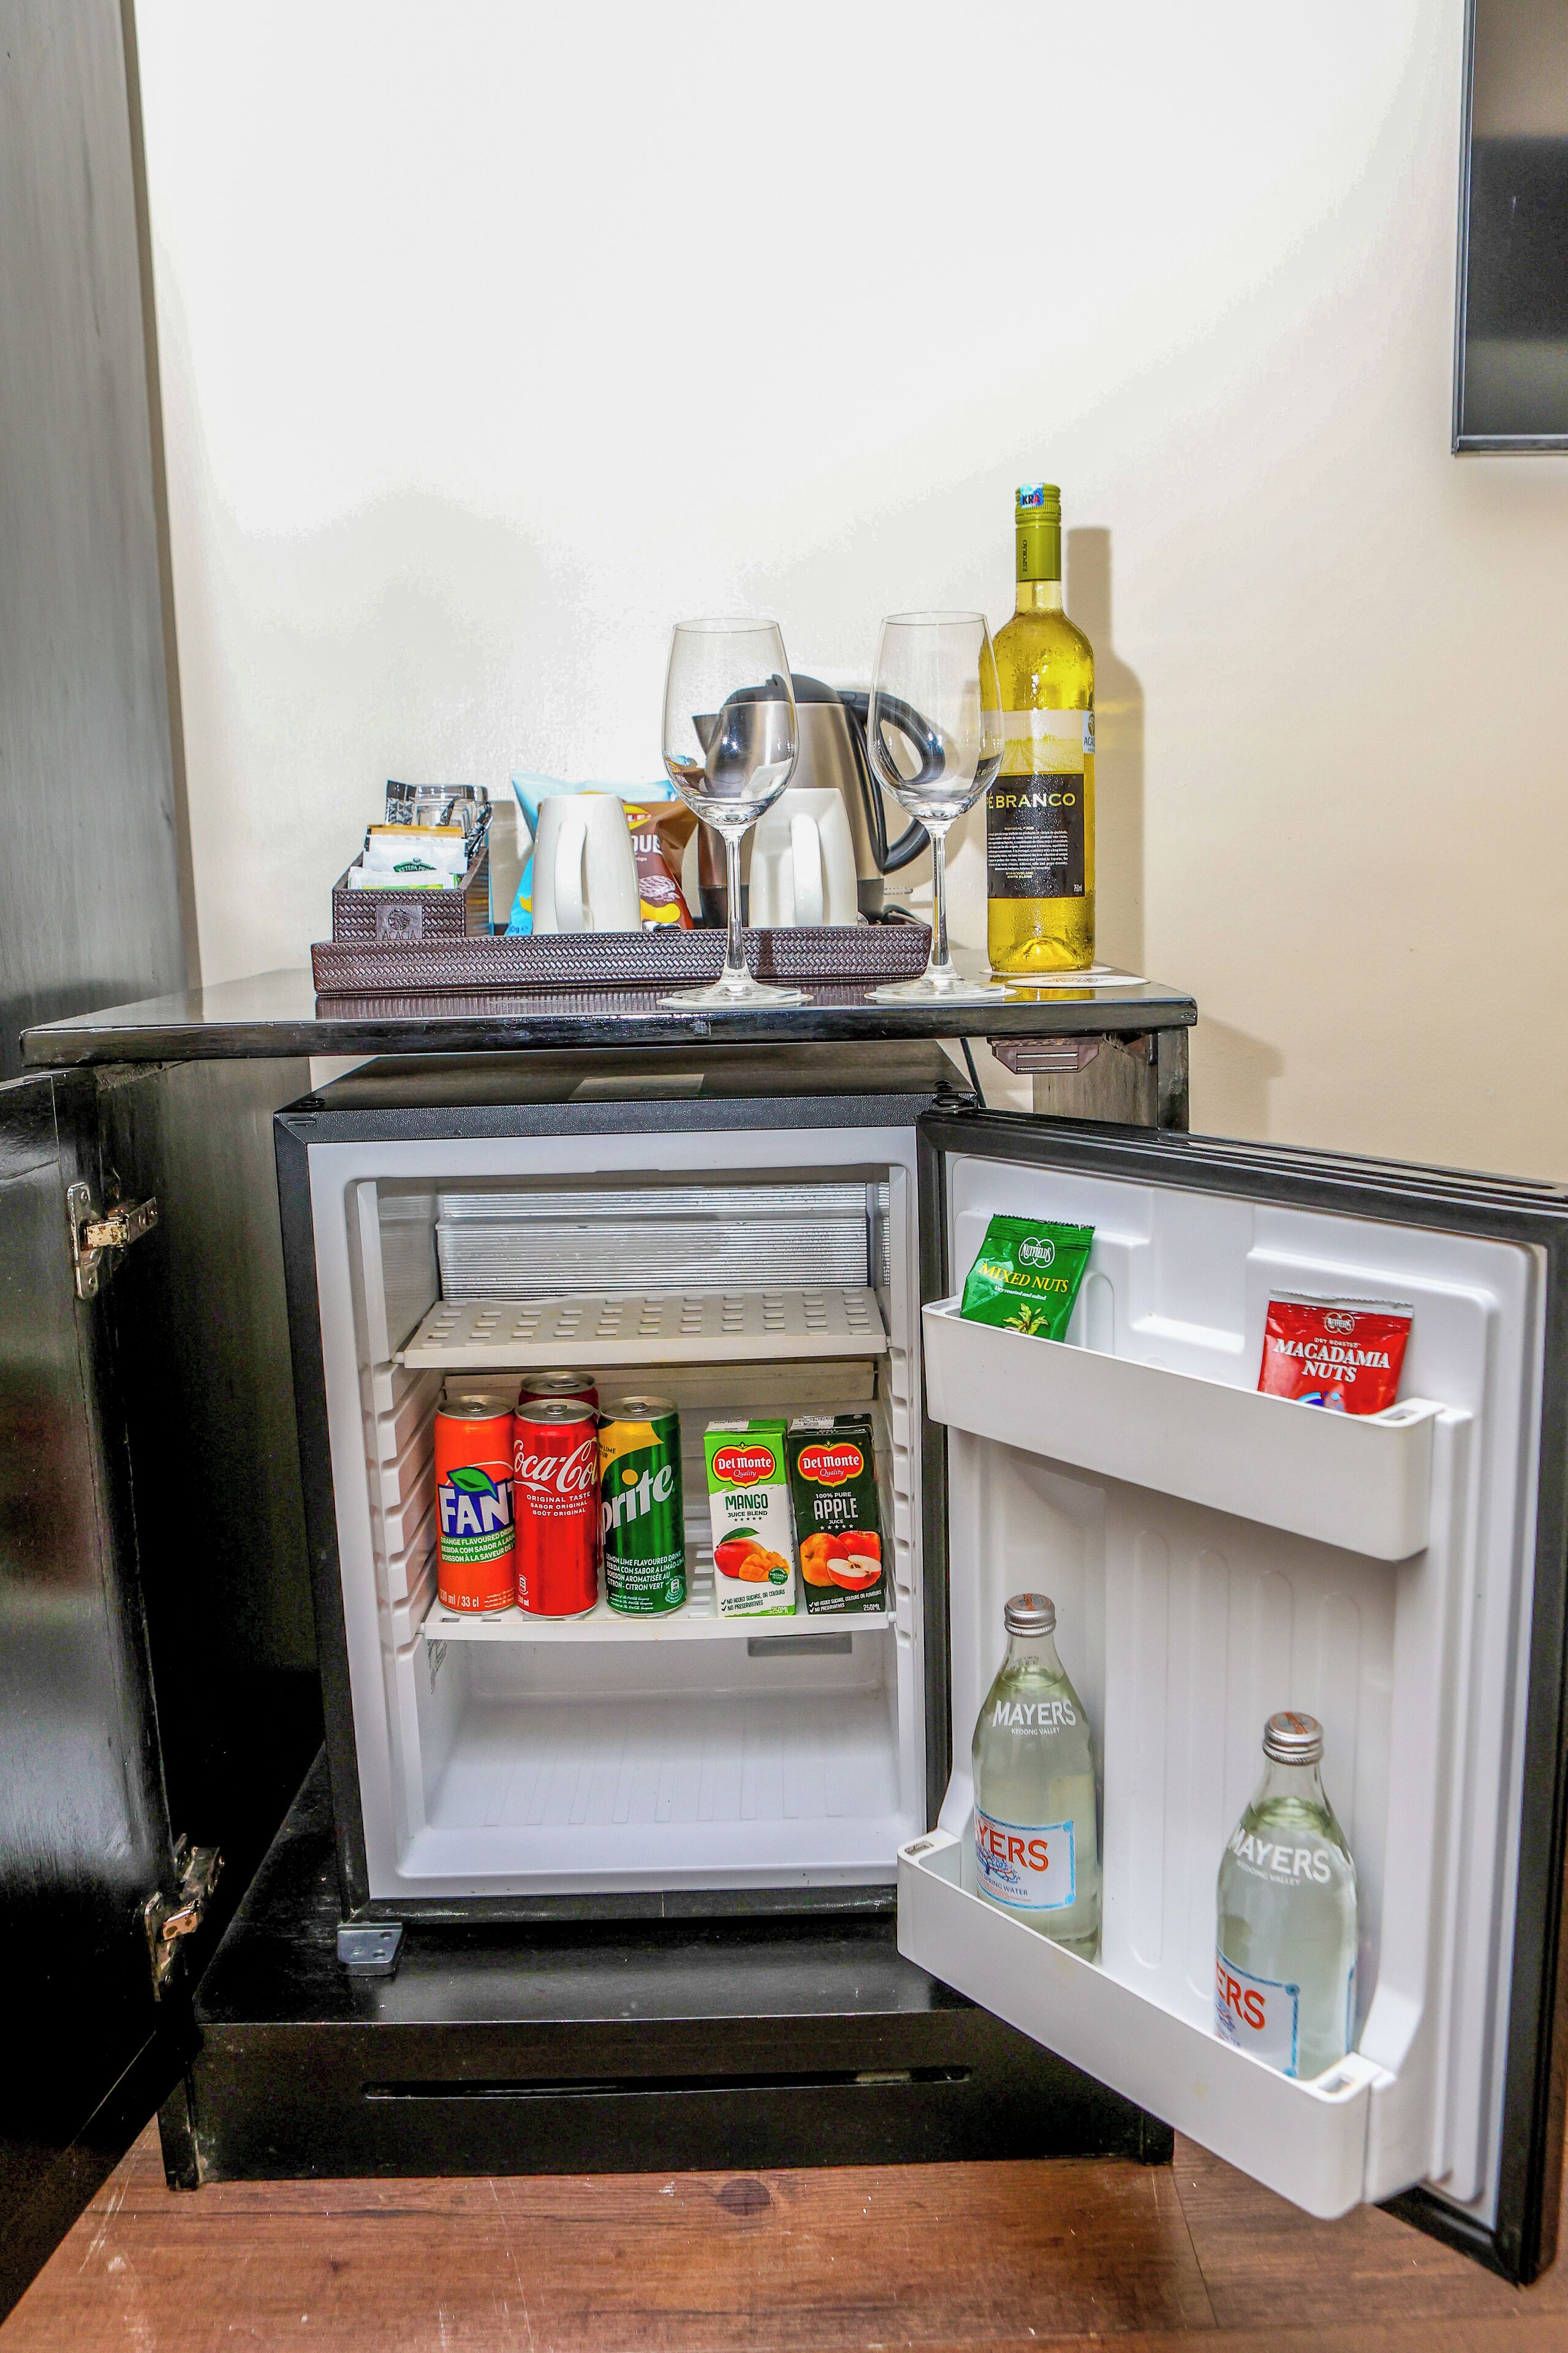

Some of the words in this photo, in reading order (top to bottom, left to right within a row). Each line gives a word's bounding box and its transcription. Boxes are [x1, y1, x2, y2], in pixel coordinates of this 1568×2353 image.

[1023, 493, 1040, 505] KRA
[996, 793, 1076, 809] BRANCO
[382, 931, 417, 941] ACACIA
[1021, 1244, 1051, 1263] NUTFIELDS
[977, 1262, 1031, 1286] MIXED
[1031, 1276, 1069, 1293] NUTS
[994, 1285, 1005, 1294] Dry
[1329, 1339, 1358, 1348] ROASTED
[1273, 1338, 1391, 1369] MACADAMIA
[1301, 1360, 1357, 1383] NUTS
[718, 1458, 736, 1470] Del
[737, 1457, 771, 1469] Monte
[803, 1457, 822, 1469] Del
[822, 1455, 860, 1468] Monte
[733, 1469, 757, 1478] Quality
[820, 1468, 844, 1477] Quality
[569, 1491, 591, 1501] TASTE
[725, 1493, 768, 1510] MANGO
[556, 1500, 588, 1509] ORIGINAL
[814, 1498, 858, 1520] APPLE
[553, 1508, 586, 1517] ORIGINAL
[441, 1537, 461, 1545] ORANGE
[462, 1533, 500, 1545] FLAVOURED
[441, 1545, 459, 1553] BEBIDA
[475, 1542, 497, 1552] SABOR
[480, 1548, 504, 1560] SAVEUR
[606, 1553, 619, 1563] LEMON
[634, 1556, 667, 1566] FLAVOURED
[668, 1550, 681, 1561] DRINK
[607, 1561, 620, 1572] BEBIDA
[621, 1566, 634, 1574] COM
[607, 1569, 625, 1581] BOISSON
[625, 1572, 662, 1582] AROMATISÉE
[662, 1572, 670, 1580] AU
[607, 1577, 623, 1588] CITRON
[649, 1582, 664, 1590] VERT
[448, 1594, 456, 1605] ml
[461, 1596, 471, 1607] 33
[472, 1596, 479, 1607] cl
[735, 1600, 763, 1610] PRESERVATIVES
[992, 1699, 1077, 1727] MAYERS
[1012, 1727, 1038, 1736] KEDONG
[1039, 1727, 1060, 1735] VALLEY
[975, 1817, 1049, 1872] YERS
[1227, 1824, 1331, 1884] MAYERS
[983, 1874, 1002, 1889] SPRING
[1003, 1885, 1028, 1896] WATER
